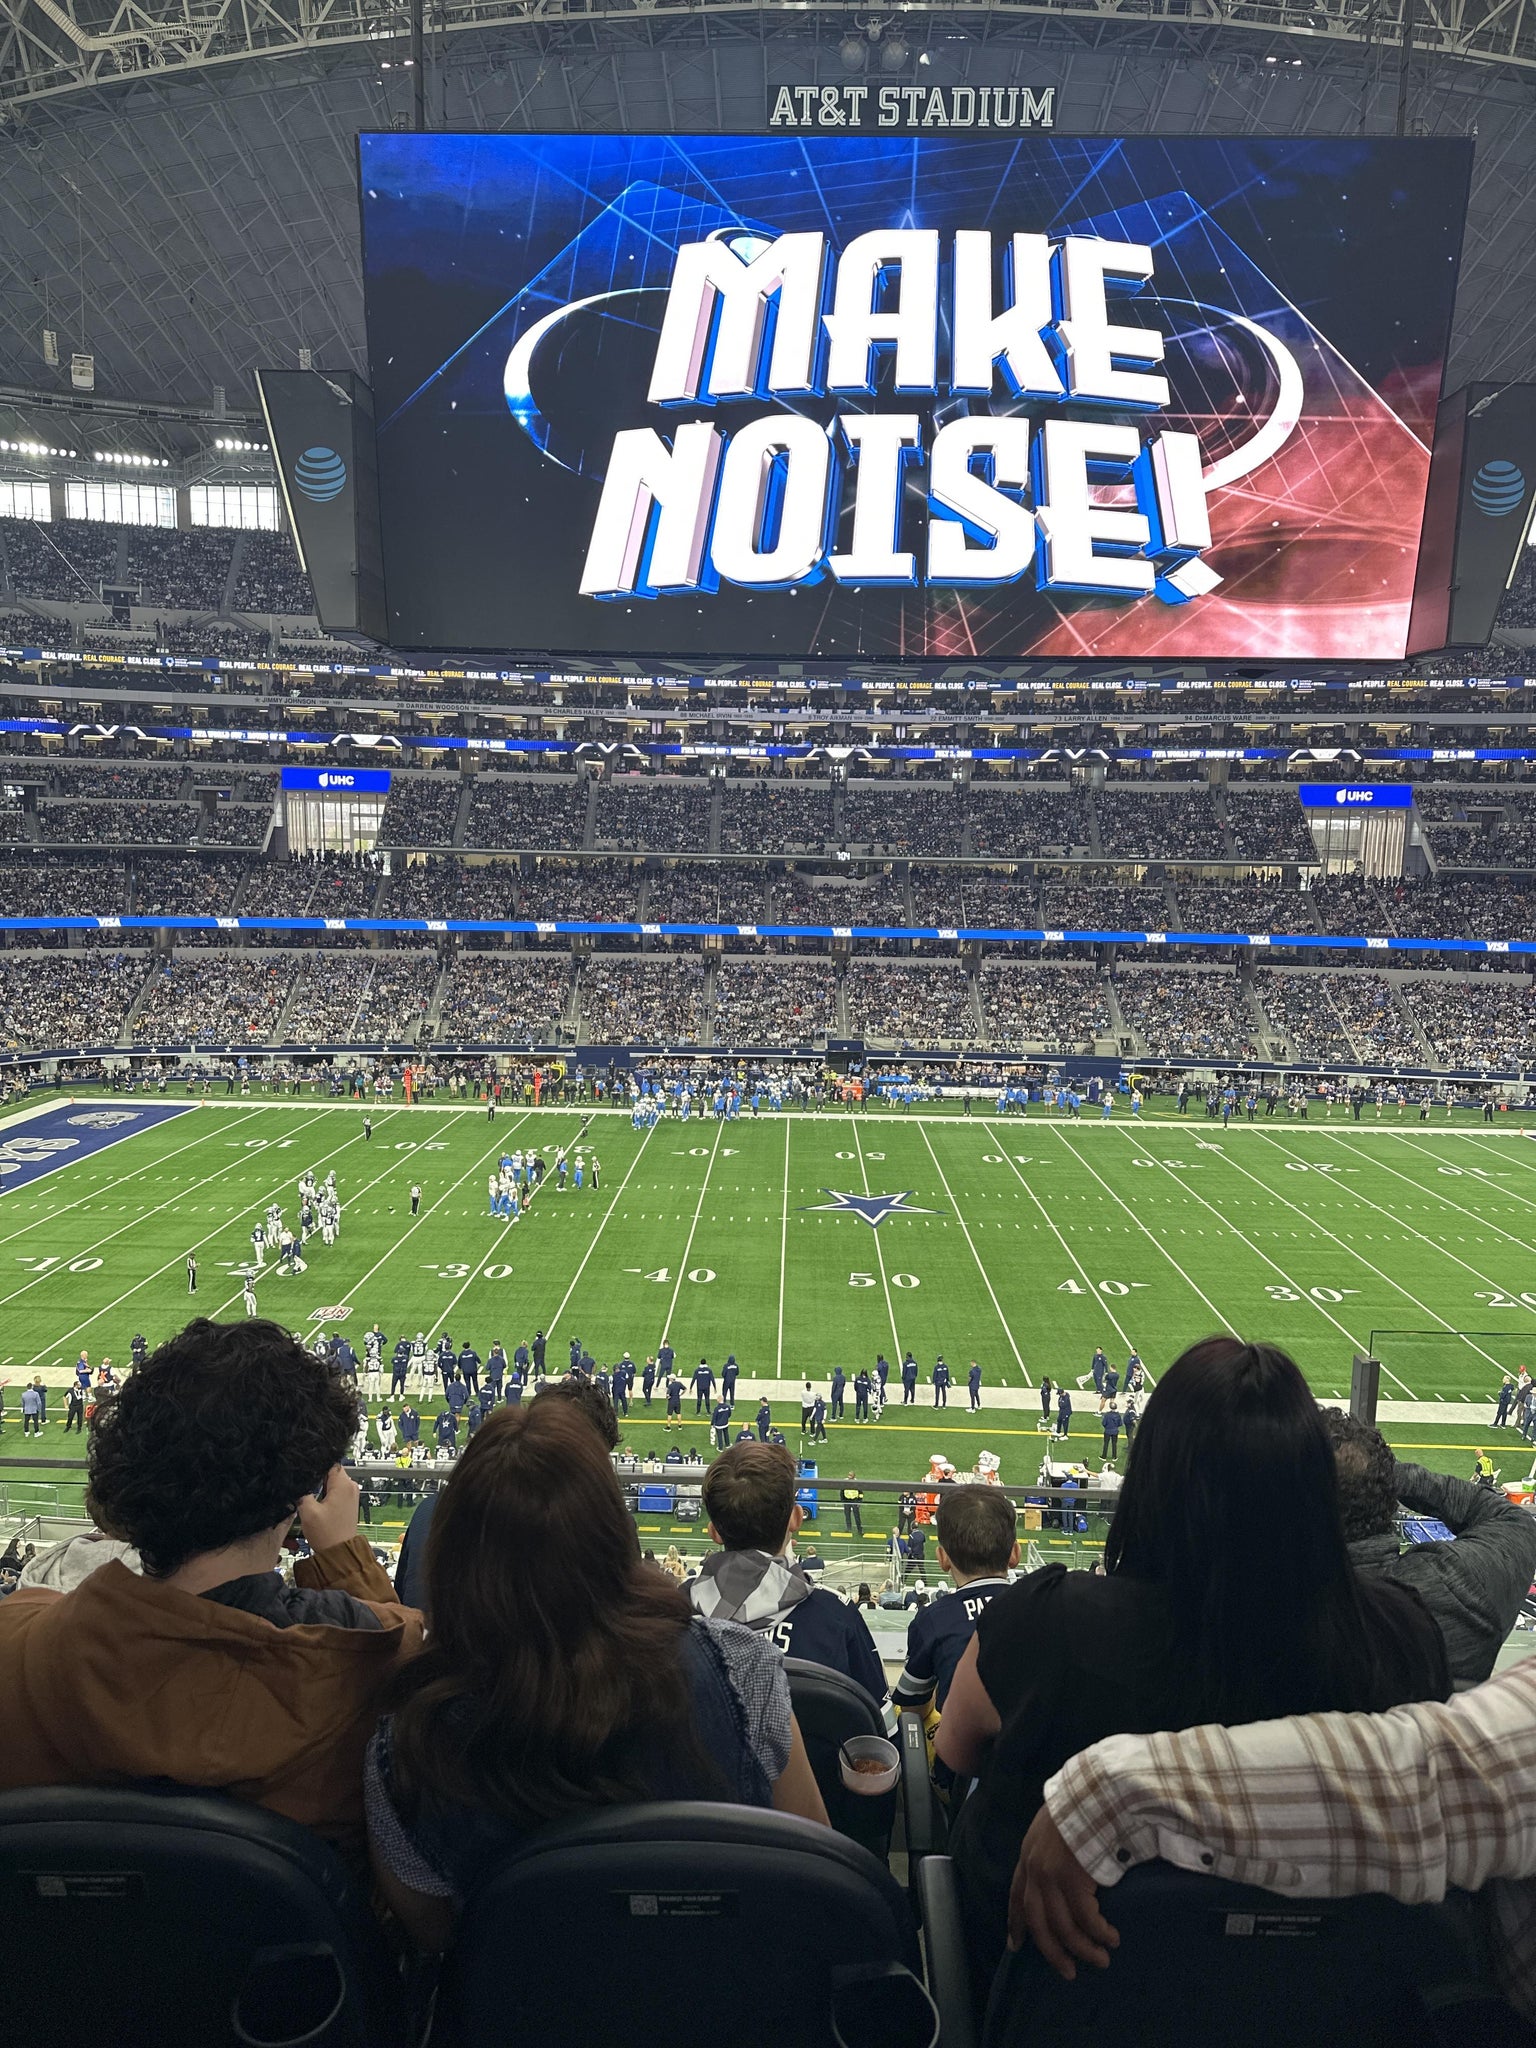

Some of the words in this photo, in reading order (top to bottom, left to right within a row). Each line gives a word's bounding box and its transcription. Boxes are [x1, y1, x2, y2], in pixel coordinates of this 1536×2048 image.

[770, 85, 868, 127] AT&T
[878, 85, 1056, 128] STADIUM
[647, 228, 1171, 409] MAKE
[578, 413, 1224, 606] NOISE!
[42, 652, 57, 660] REAL
[83, 654, 98, 662] REAL
[128, 656, 142, 664] REAL
[219, 661, 233, 669] REAL
[391, 668, 404, 676] REAL
[330, 774, 354, 786] UHC
[1347, 791, 1373, 801] UHC
[96, 918, 121, 927] VISA
[216, 918, 239, 928] VISA
[324, 920, 346, 929] VISA
[426, 921, 448, 930] VISA
[536, 922, 556, 932] VISA
[640, 924, 661, 933] VISA
[737, 926, 757, 935] VISA
[832, 927, 852, 937] VISA
[937, 930, 958, 939] VISA
[1043, 931, 1064, 941] VISA
[1145, 933, 1166, 943] VISA
[1248, 935, 1270, 945] VISA
[1366, 938, 1388, 948] VISA
[1485, 942, 1510, 952] VISA
[438, 1263, 514, 1279] 30
[644, 1268, 717, 1283] 40
[848, 1272, 920, 1289] 50
[1056, 1278, 1130, 1295] 40
[1264, 1285, 1344, 1302] 30
